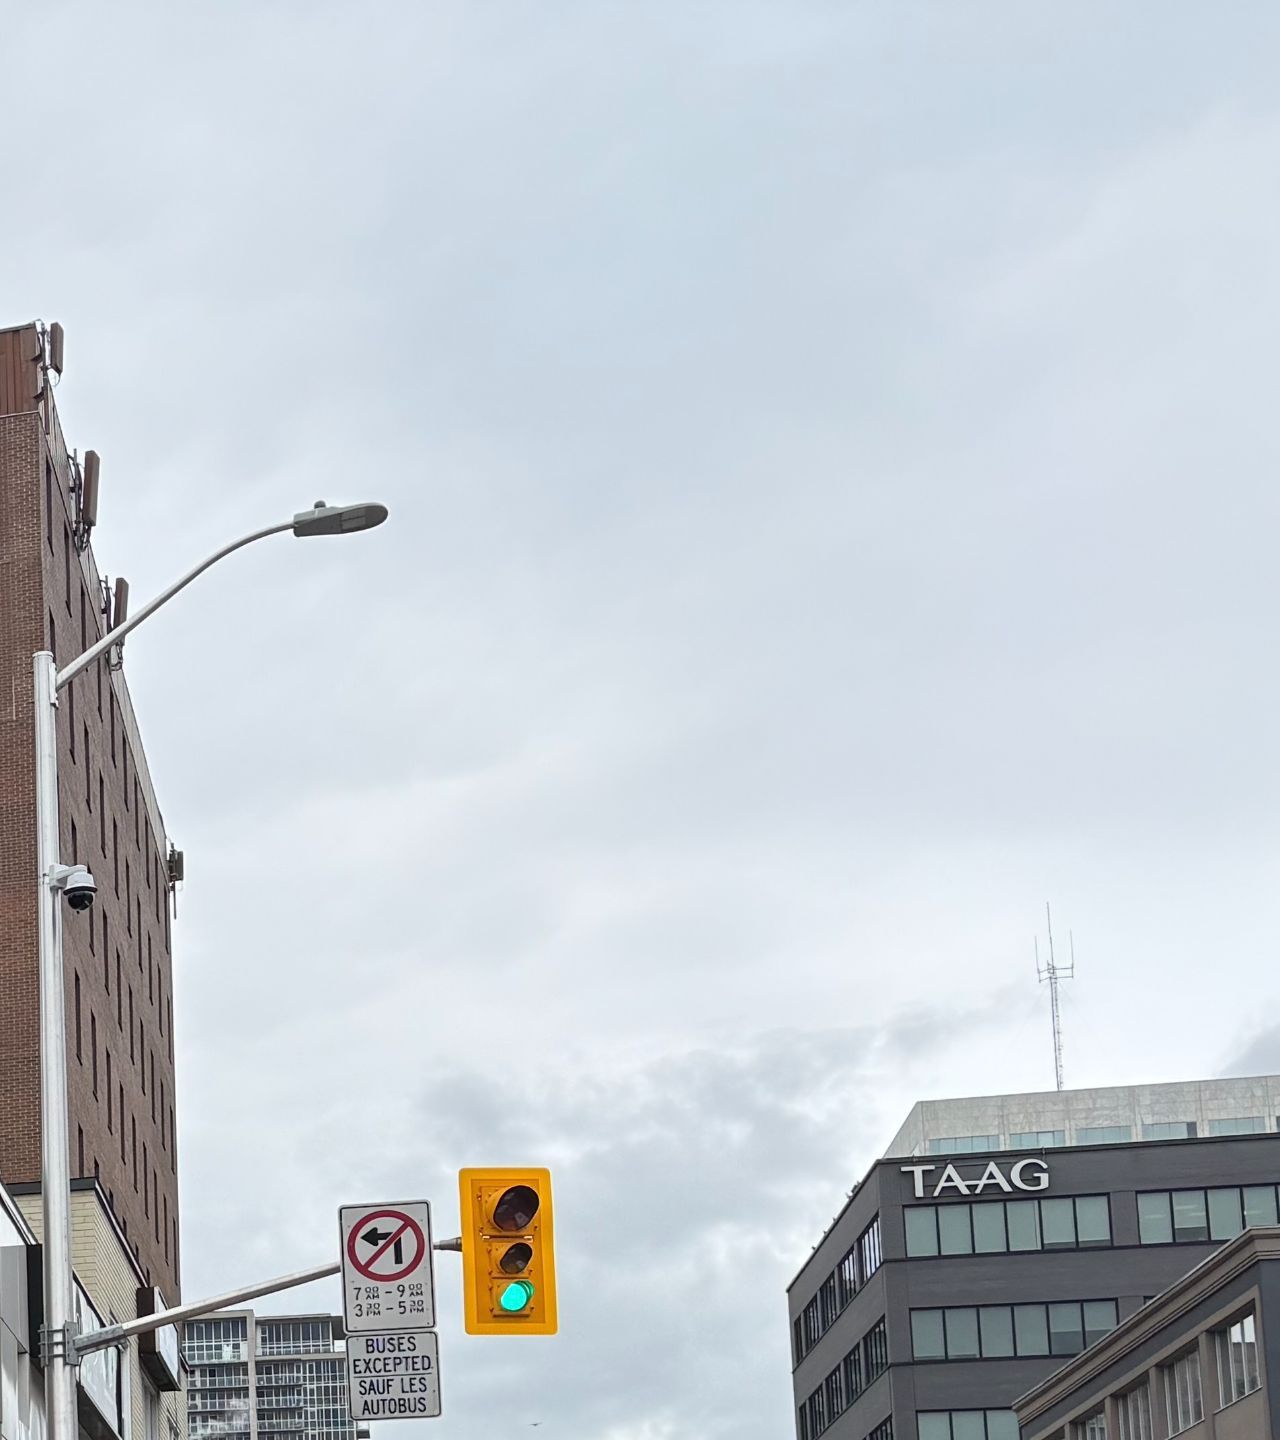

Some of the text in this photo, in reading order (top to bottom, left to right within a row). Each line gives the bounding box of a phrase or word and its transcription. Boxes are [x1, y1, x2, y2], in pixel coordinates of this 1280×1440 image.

[900, 1158, 1050, 1198] TAAG
[353, 1287, 362, 1301] 7
[396, 1284, 406, 1298] 9
[353, 1303, 364, 1318] 3
[398, 1300, 407, 1315] 5
[365, 1336, 417, 1354] BUSES
[353, 1355, 432, 1375] EXCEPTED
[358, 1377, 428, 1396] SAUF LES
[361, 1396, 427, 1416] AUTOBUS
